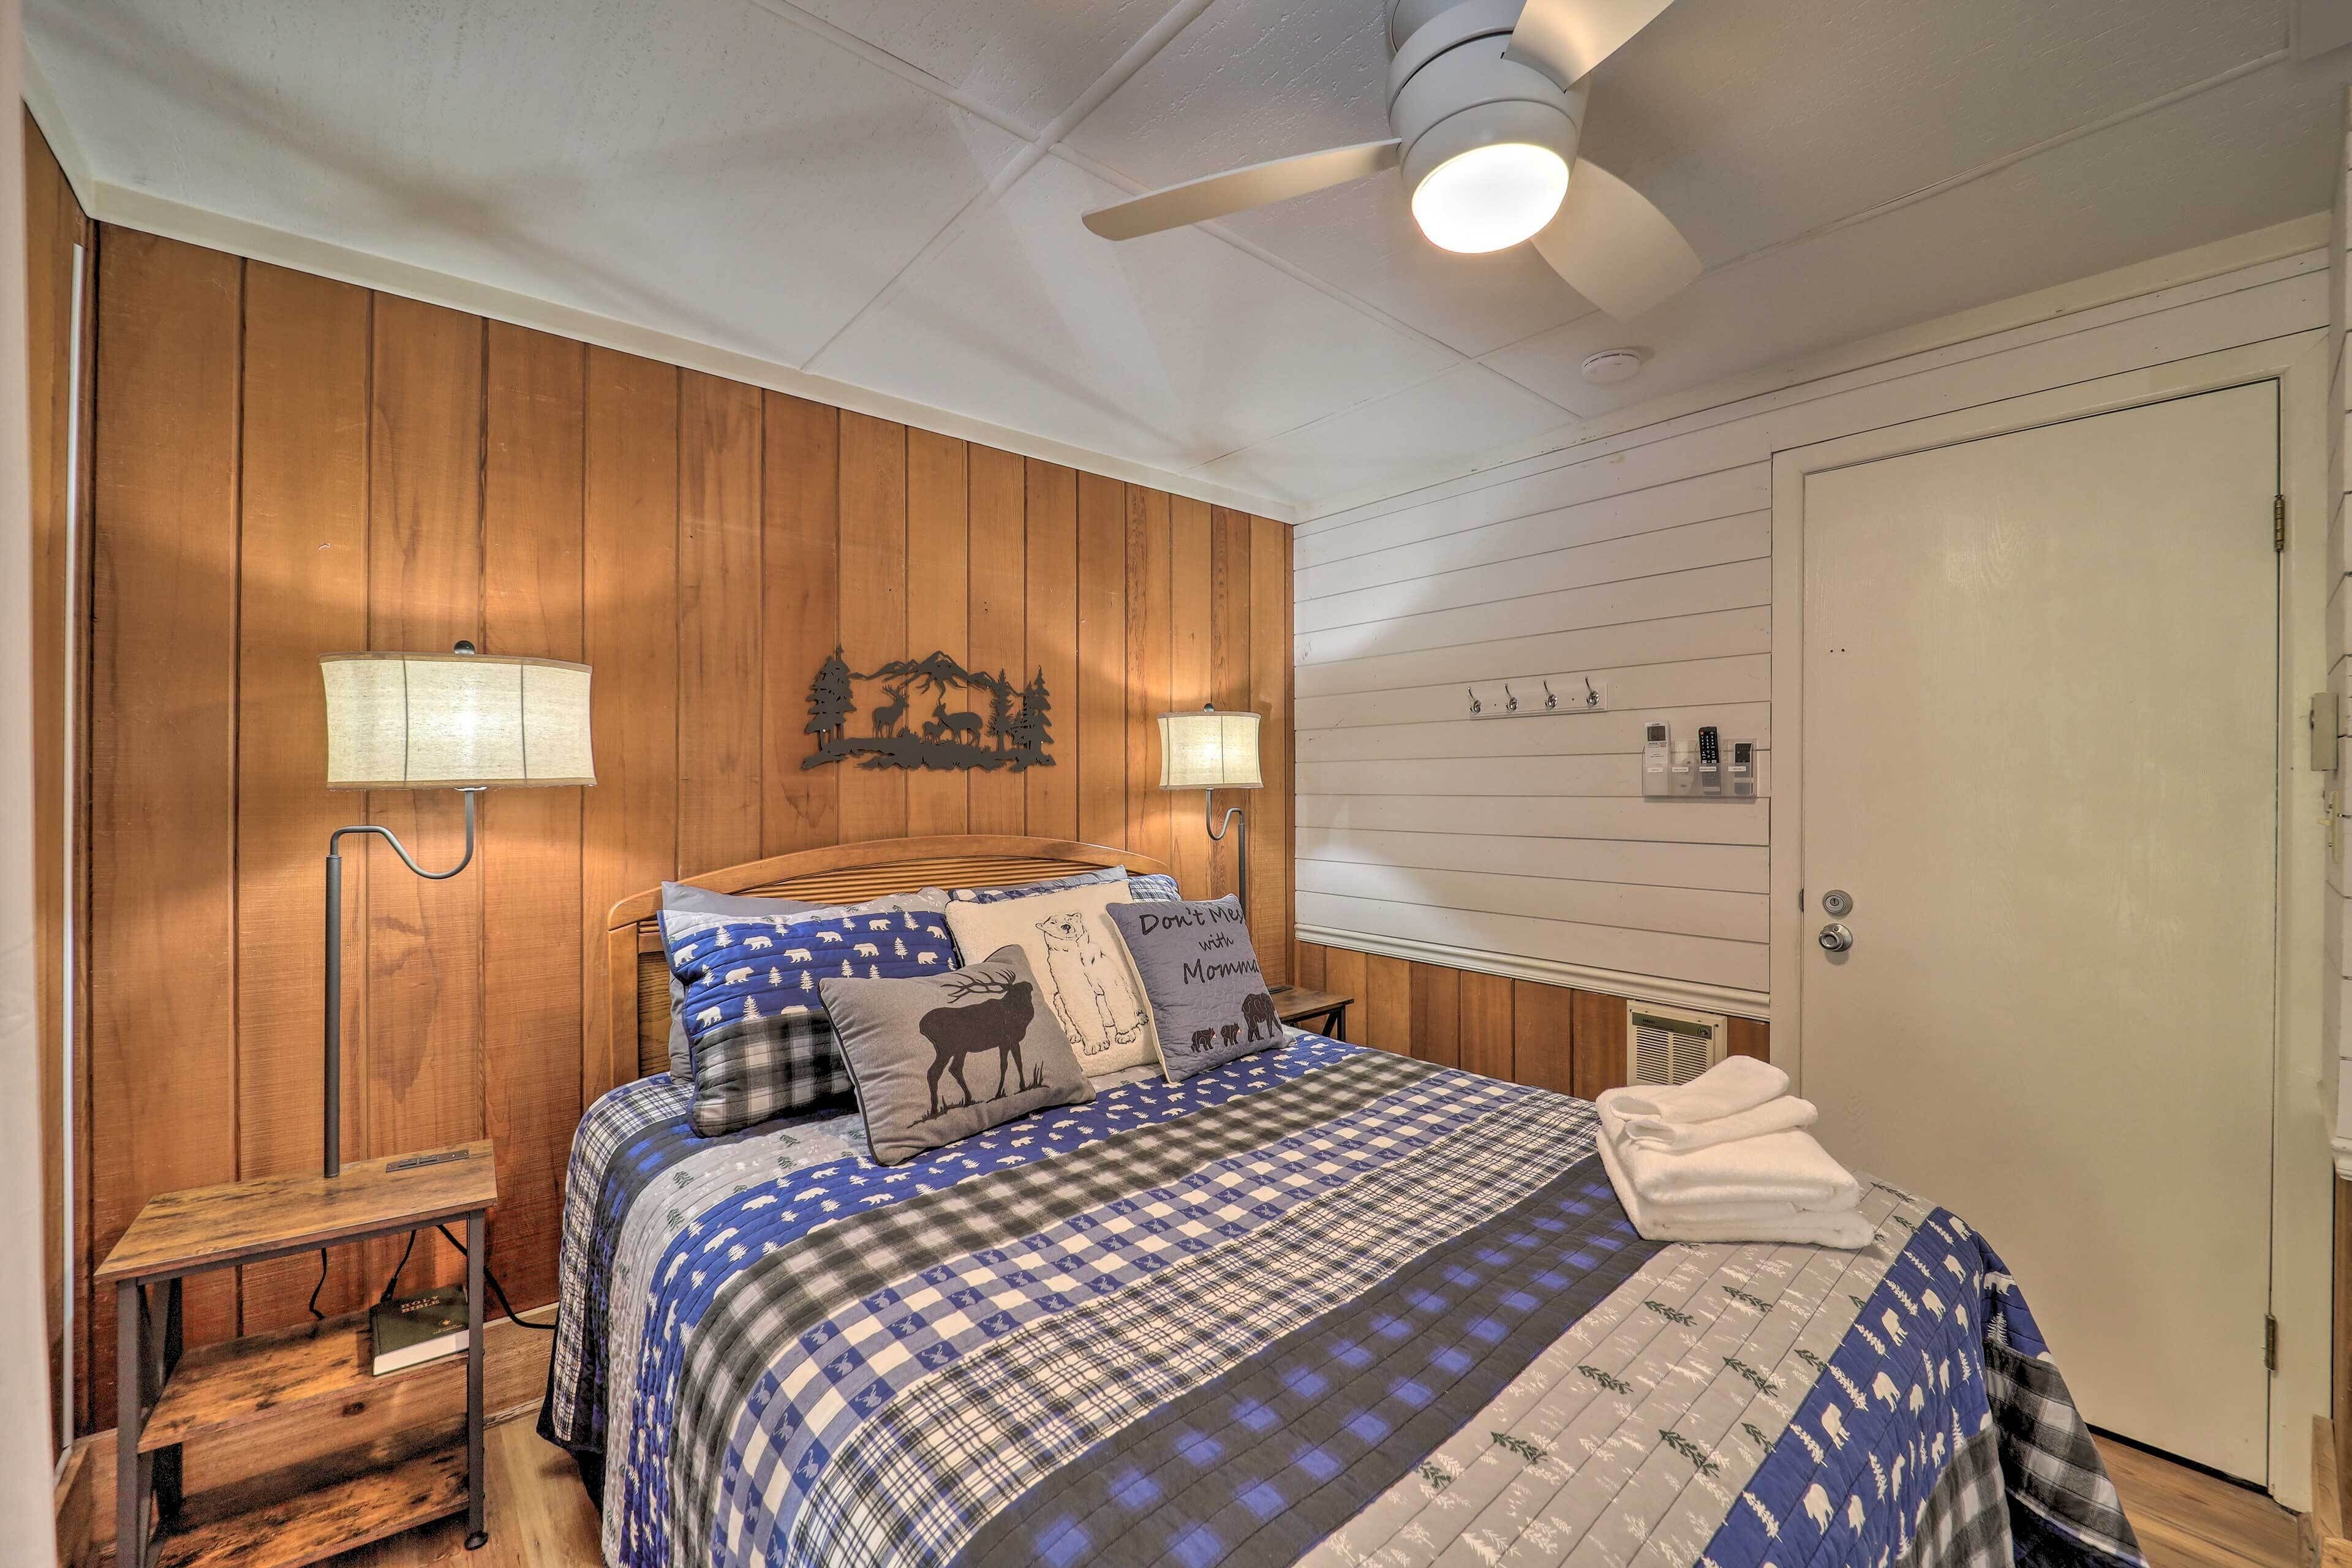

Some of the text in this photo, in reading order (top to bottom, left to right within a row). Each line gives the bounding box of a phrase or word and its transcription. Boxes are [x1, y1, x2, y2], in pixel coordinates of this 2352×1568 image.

[1139, 907, 1243, 935] Don't Mes
[1198, 932, 1234, 952] with
[1183, 958, 1259, 984] Momma
[401, 1295, 439, 1308] HOLY
[401, 1300, 440, 1313] BIBLE
